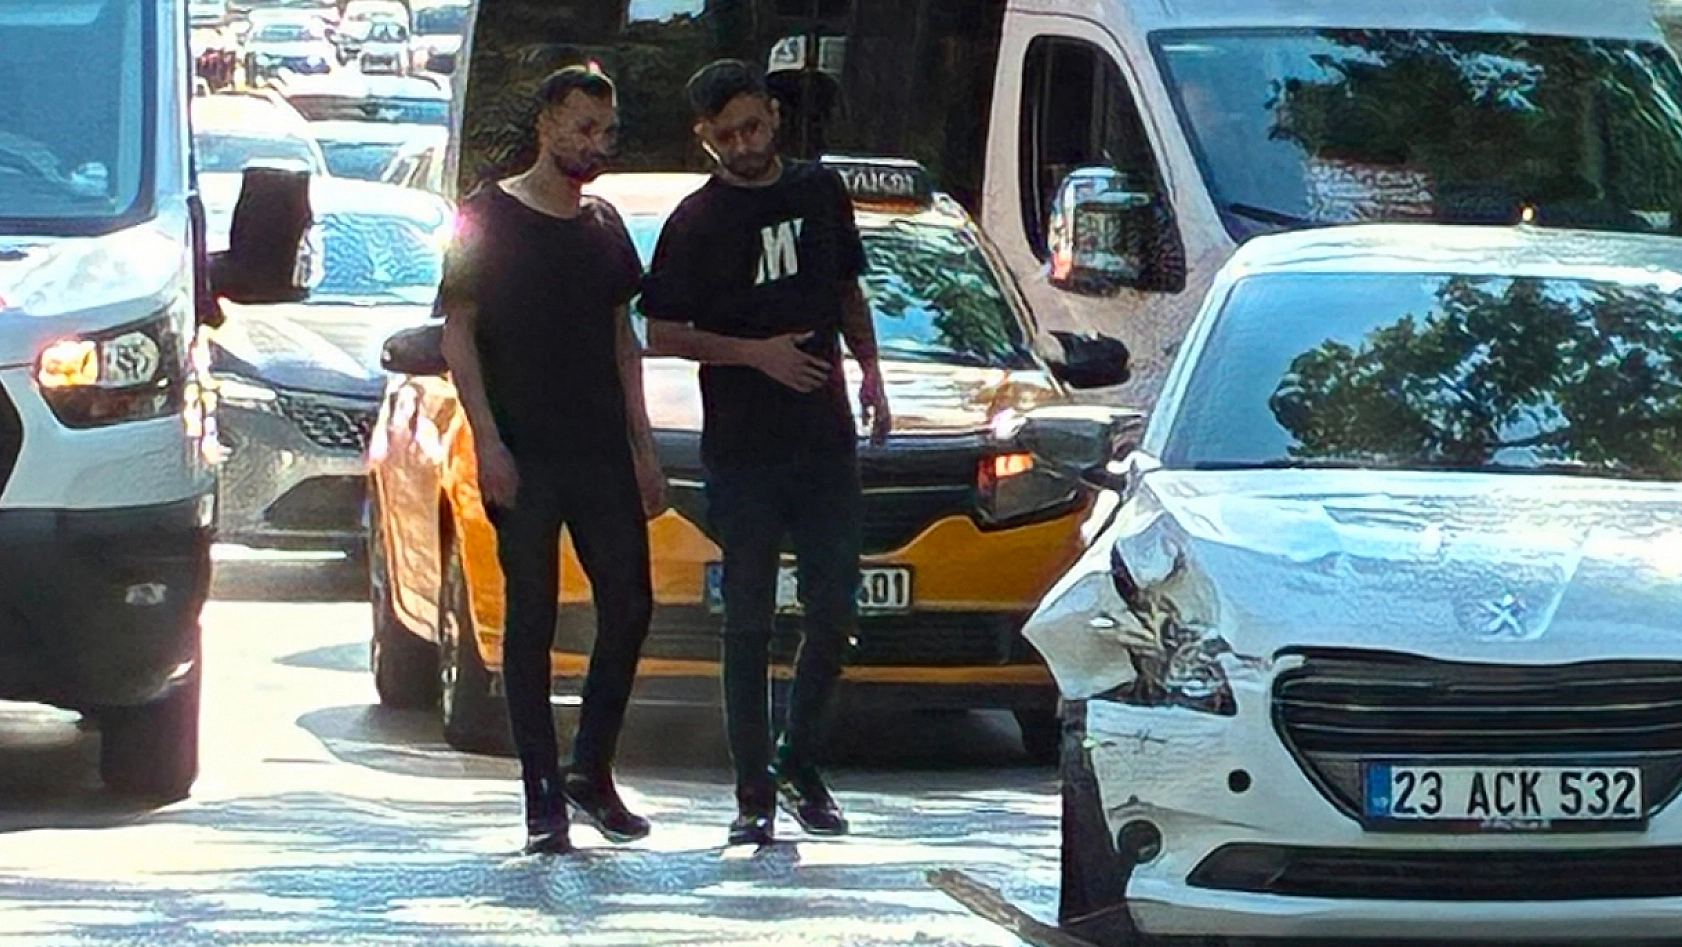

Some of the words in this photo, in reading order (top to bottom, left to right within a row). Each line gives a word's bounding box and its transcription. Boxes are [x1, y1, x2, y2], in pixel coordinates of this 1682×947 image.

[1393, 771, 1443, 815] 23
[1467, 771, 1543, 816] ACK
[1559, 771, 1637, 816] 532
